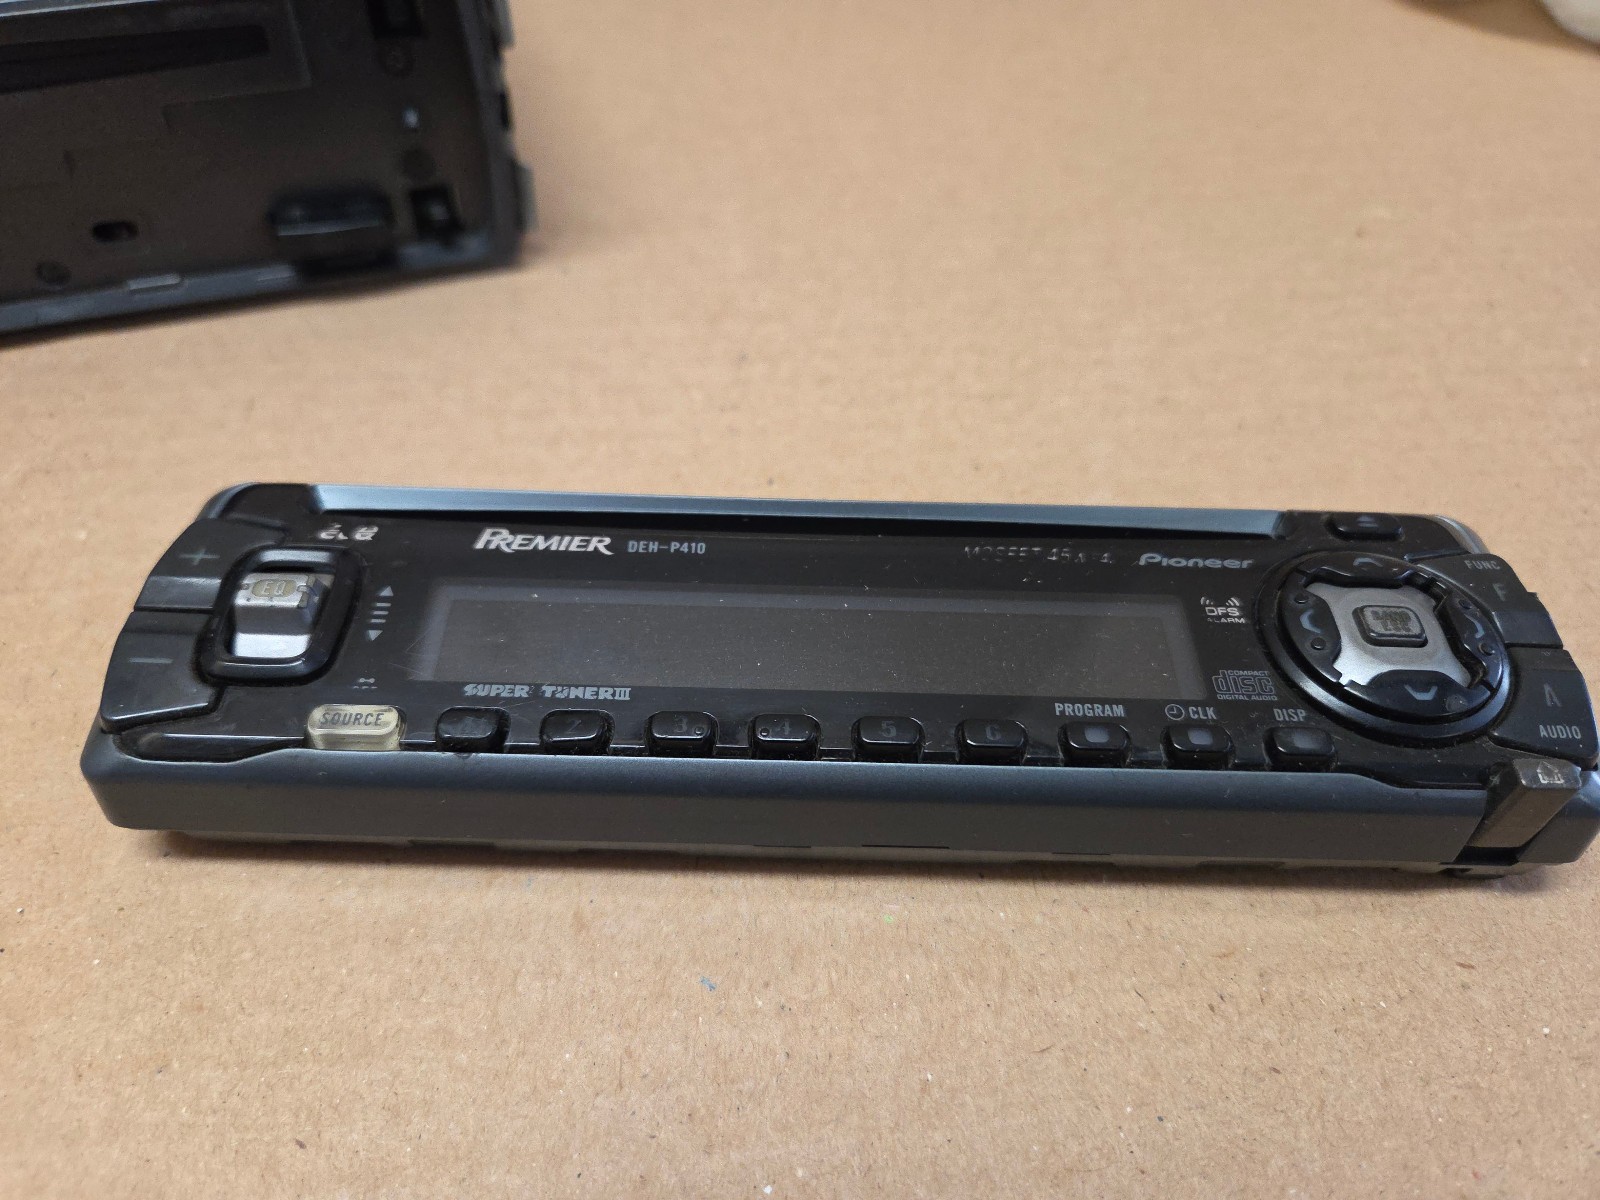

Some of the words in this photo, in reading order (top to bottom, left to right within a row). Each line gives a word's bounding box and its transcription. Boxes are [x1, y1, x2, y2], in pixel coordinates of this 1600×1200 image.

[474, 528, 615, 555] PREMIER
[627, 540, 706, 554] DEH-P410
[1138, 553, 1253, 568] Pioneer
[1464, 560, 1501, 570] FUNC
[260, 580, 286, 595] EQ
[463, 683, 531, 698] SUPER
[1055, 702, 1124, 717] PROGRAM
[1189, 706, 1217, 719] CLK
[1273, 708, 1306, 722] DISP
[319, 711, 385, 727] SOURCE
[566, 718, 582, 734] 2
[673, 714, 688, 733] 3
[777, 719, 792, 735] 4
[880, 720, 897, 738] 5
[985, 723, 1001, 741] 6
[1538, 724, 1582, 740] AUDIO
